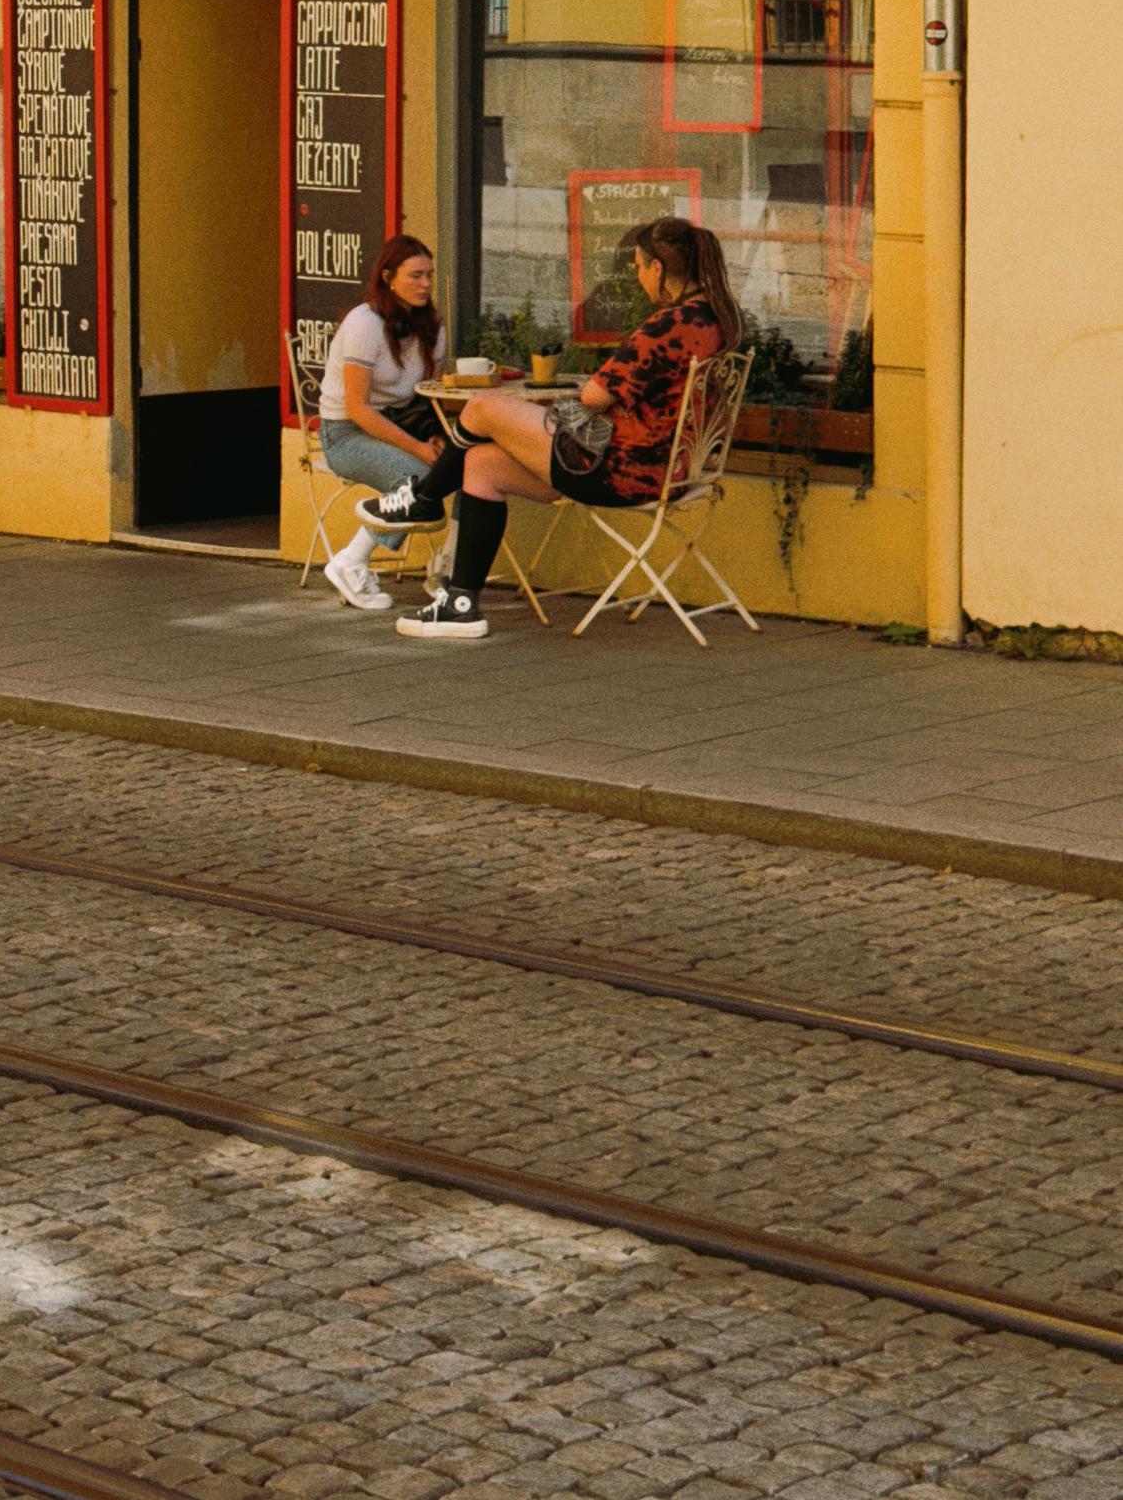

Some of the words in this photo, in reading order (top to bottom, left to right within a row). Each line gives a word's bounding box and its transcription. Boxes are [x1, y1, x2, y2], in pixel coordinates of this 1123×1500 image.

[296, 0, 388, 48] CAPPUCCINO
[17, 49, 67, 93] SÝROVÉ
[296, 46, 342, 92] LATTE
[17, 90, 92, 136] ŠPENÁTOVÉ
[296, 94, 324, 140] ČAJ
[18, 134, 93, 180] RAJČATOVÉ
[296, 141, 363, 187] DEZERTY:
[19, 177, 86, 223] TUŇÁKOVÉ
[19, 220, 78, 266] PAESANA
[296, 230, 363, 277] POLÉVKY:
[20, 264, 62, 309] PESTO
[21, 308, 70, 353] CHILLI
[22, 351, 96, 398] ARRABIATA
